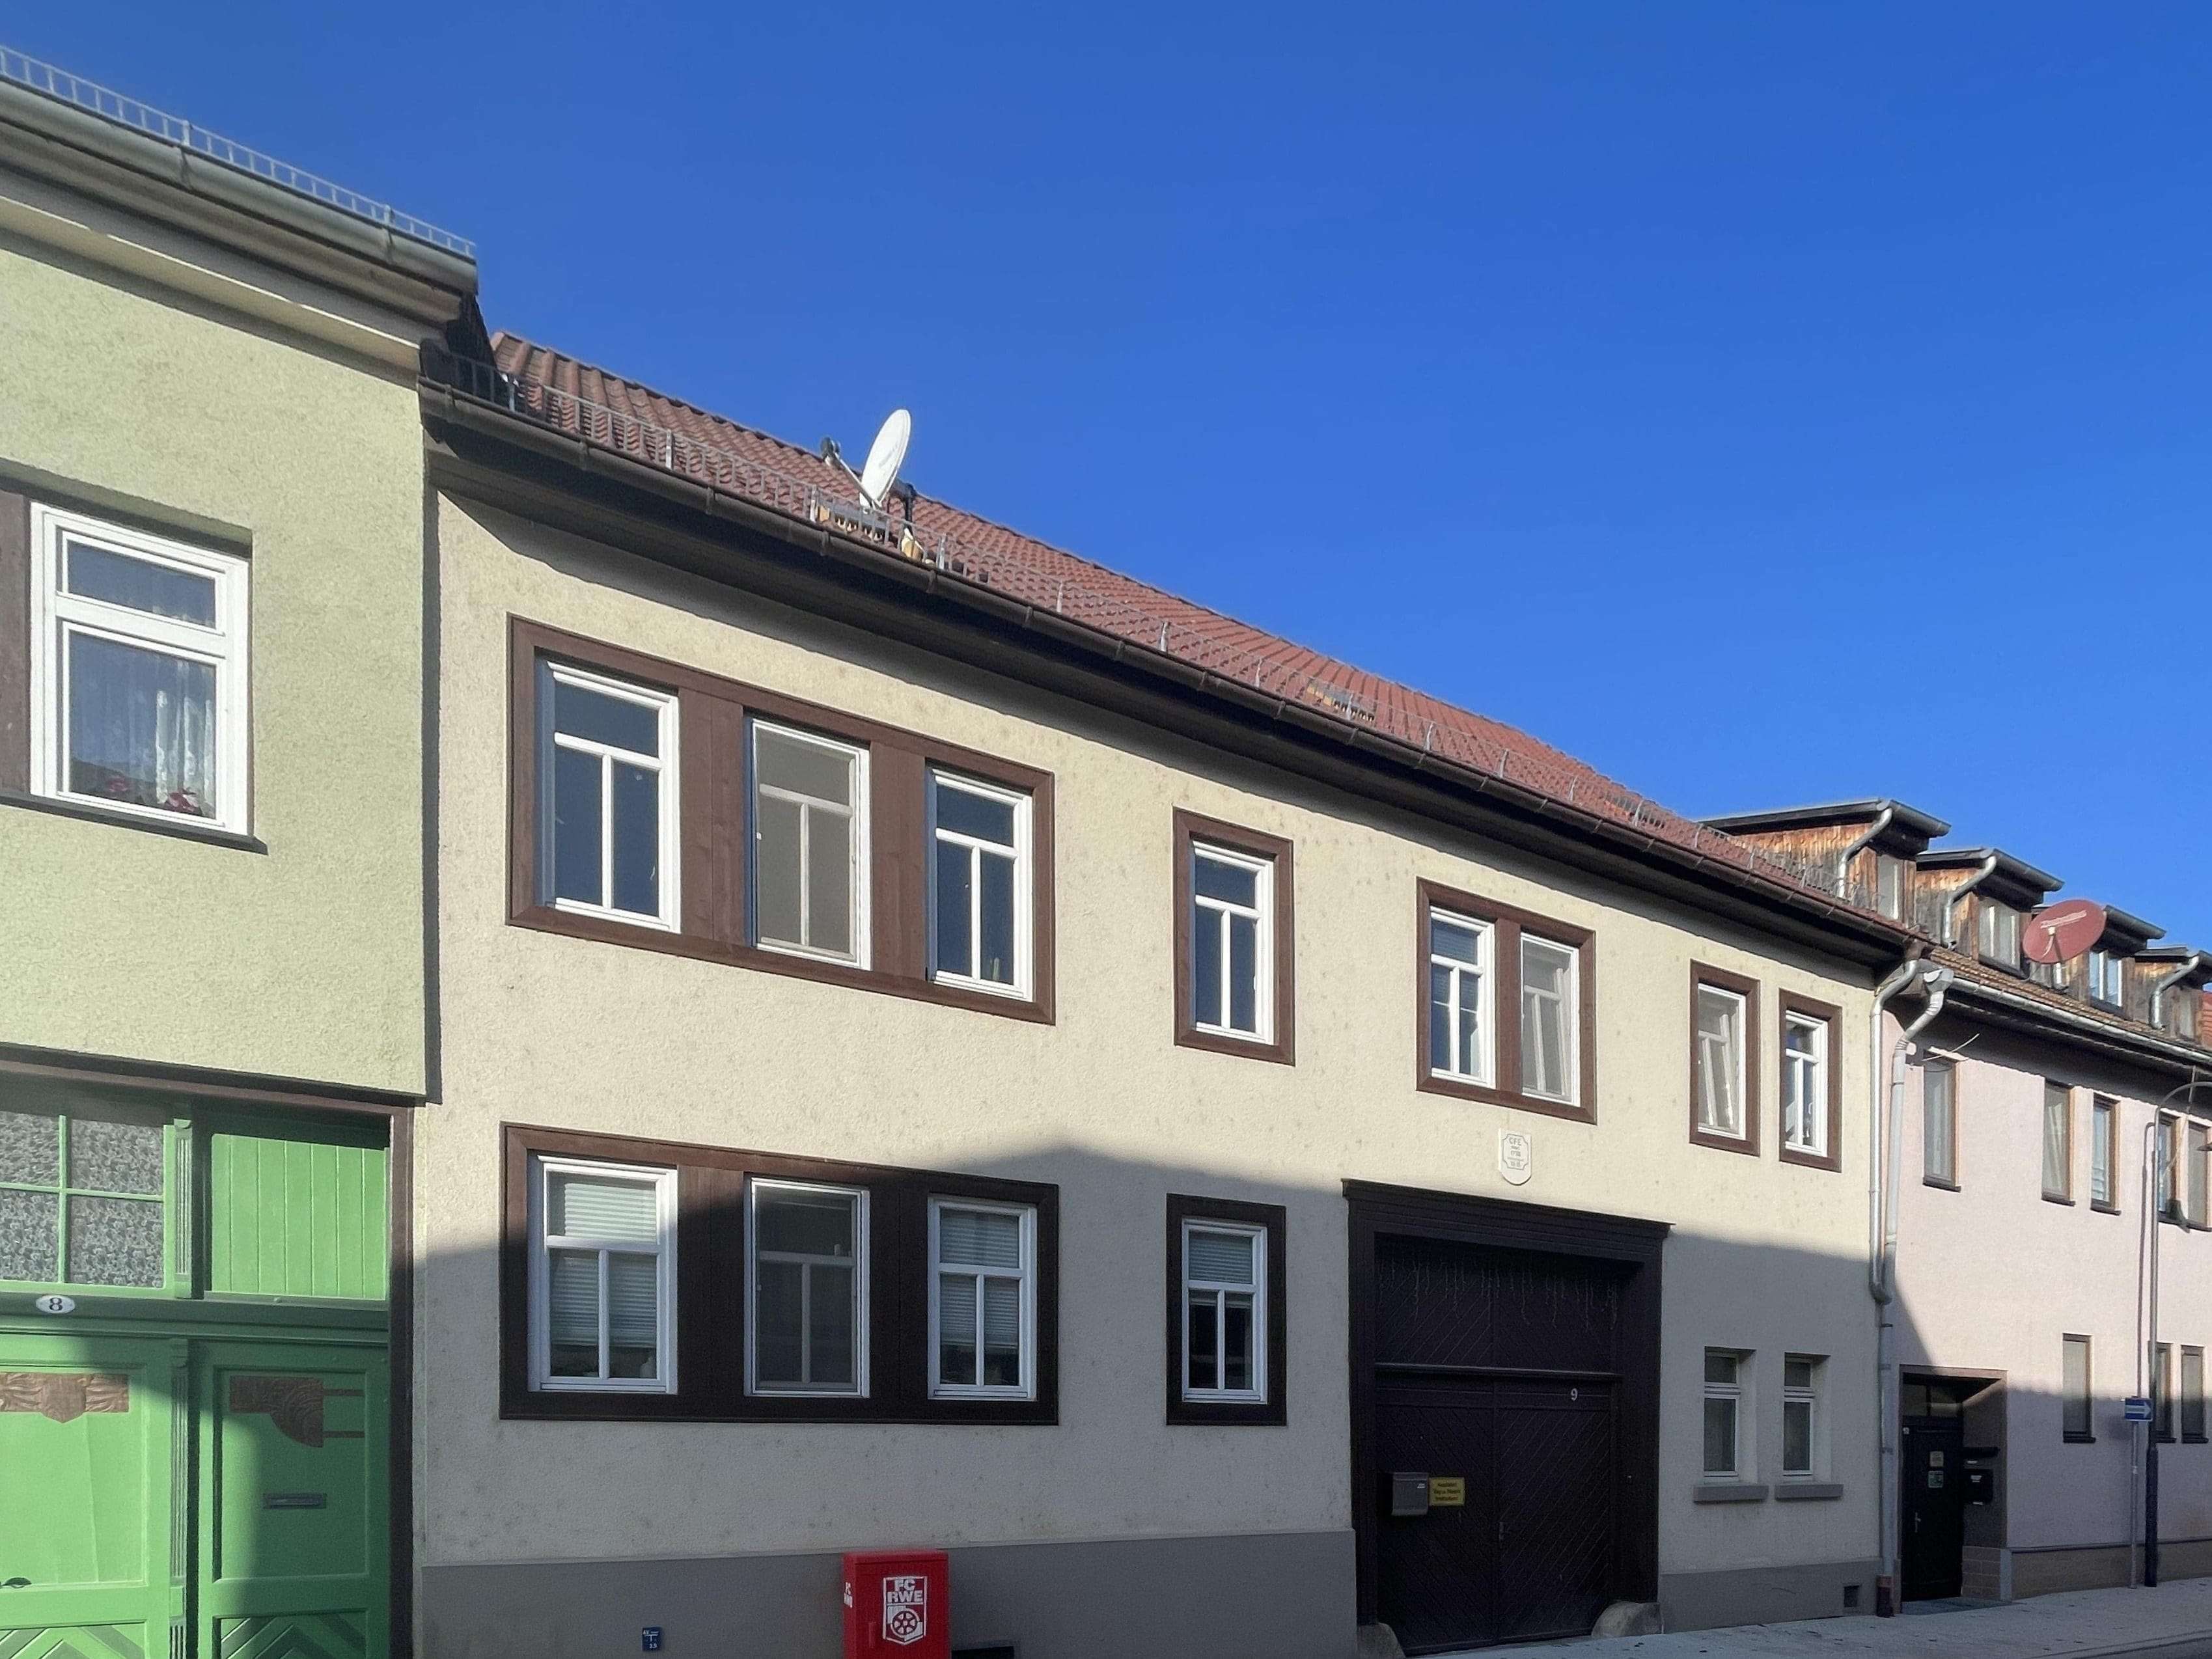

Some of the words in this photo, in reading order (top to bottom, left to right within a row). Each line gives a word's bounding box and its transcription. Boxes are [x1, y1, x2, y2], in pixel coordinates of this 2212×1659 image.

[1509, 1136, 1521, 1146] CFE
[49, 1297, 63, 1311] 8
[1571, 1388, 1578, 1401] 9
[894, 1579, 915, 1591] FC
[887, 1590, 922, 1602] RWE
